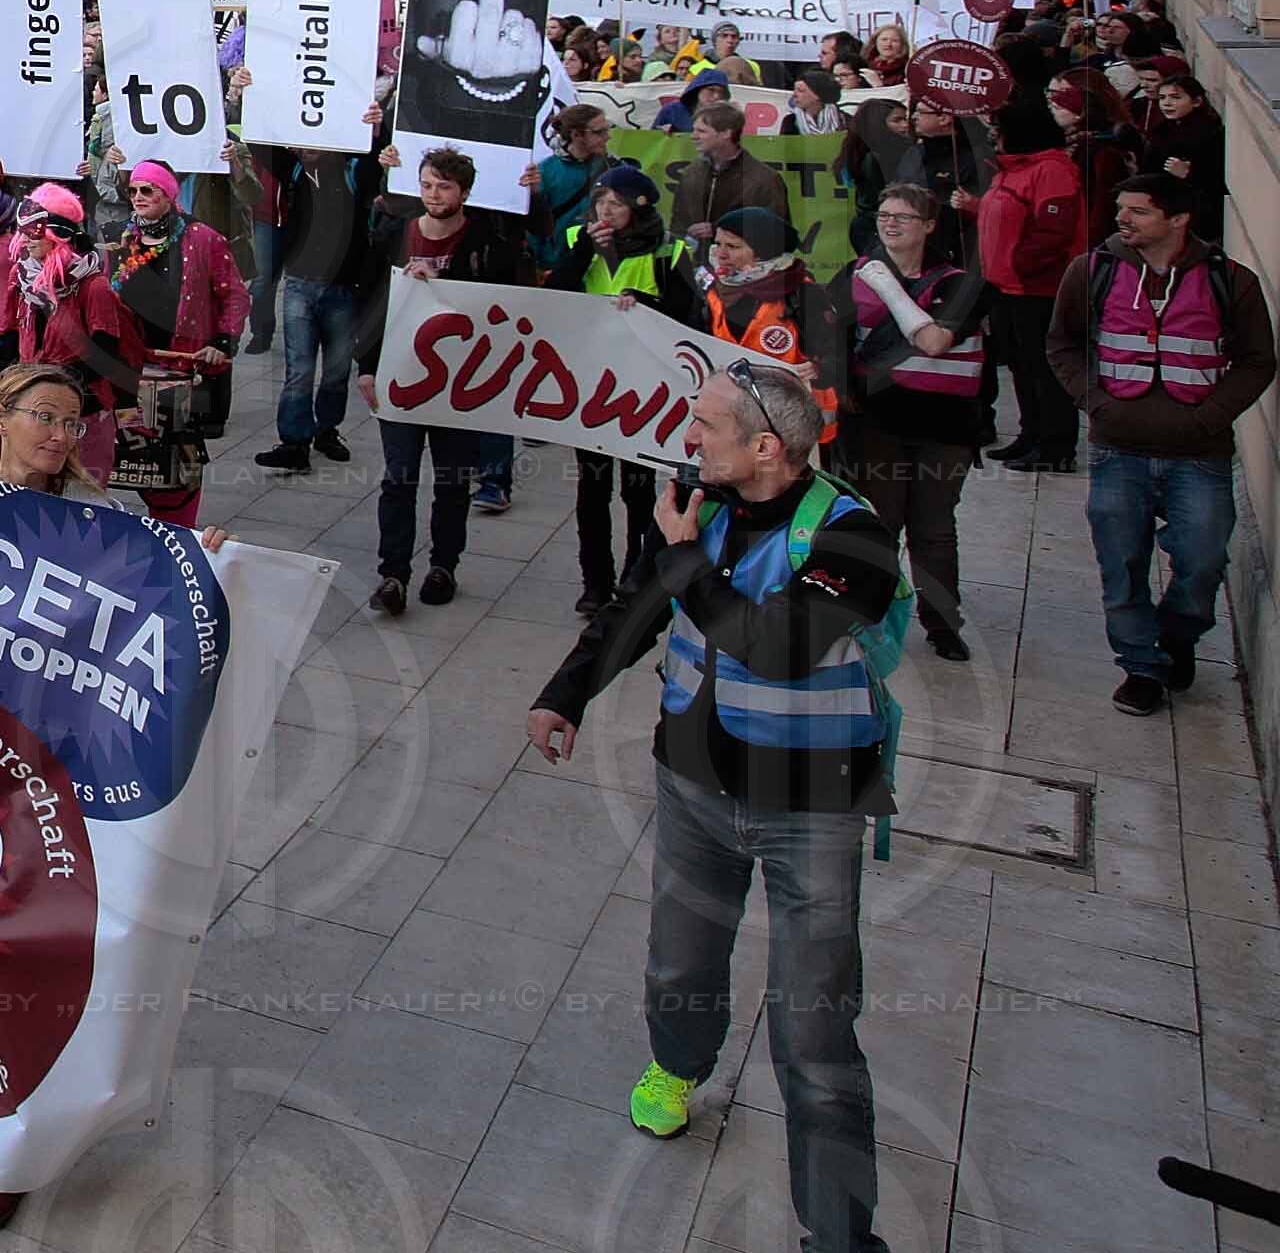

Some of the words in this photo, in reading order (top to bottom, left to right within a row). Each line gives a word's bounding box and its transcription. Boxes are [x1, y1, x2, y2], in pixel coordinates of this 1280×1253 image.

[929, 59, 994, 85] TTIP
[927, 78, 988, 96] STOPPEN
[122, 74, 207, 135] to
[108, 470, 165, 485] ascism
[120, 459, 160, 472] Smash
[140, 515, 220, 675] artnerschaft
[104, 779, 142, 804] aus
